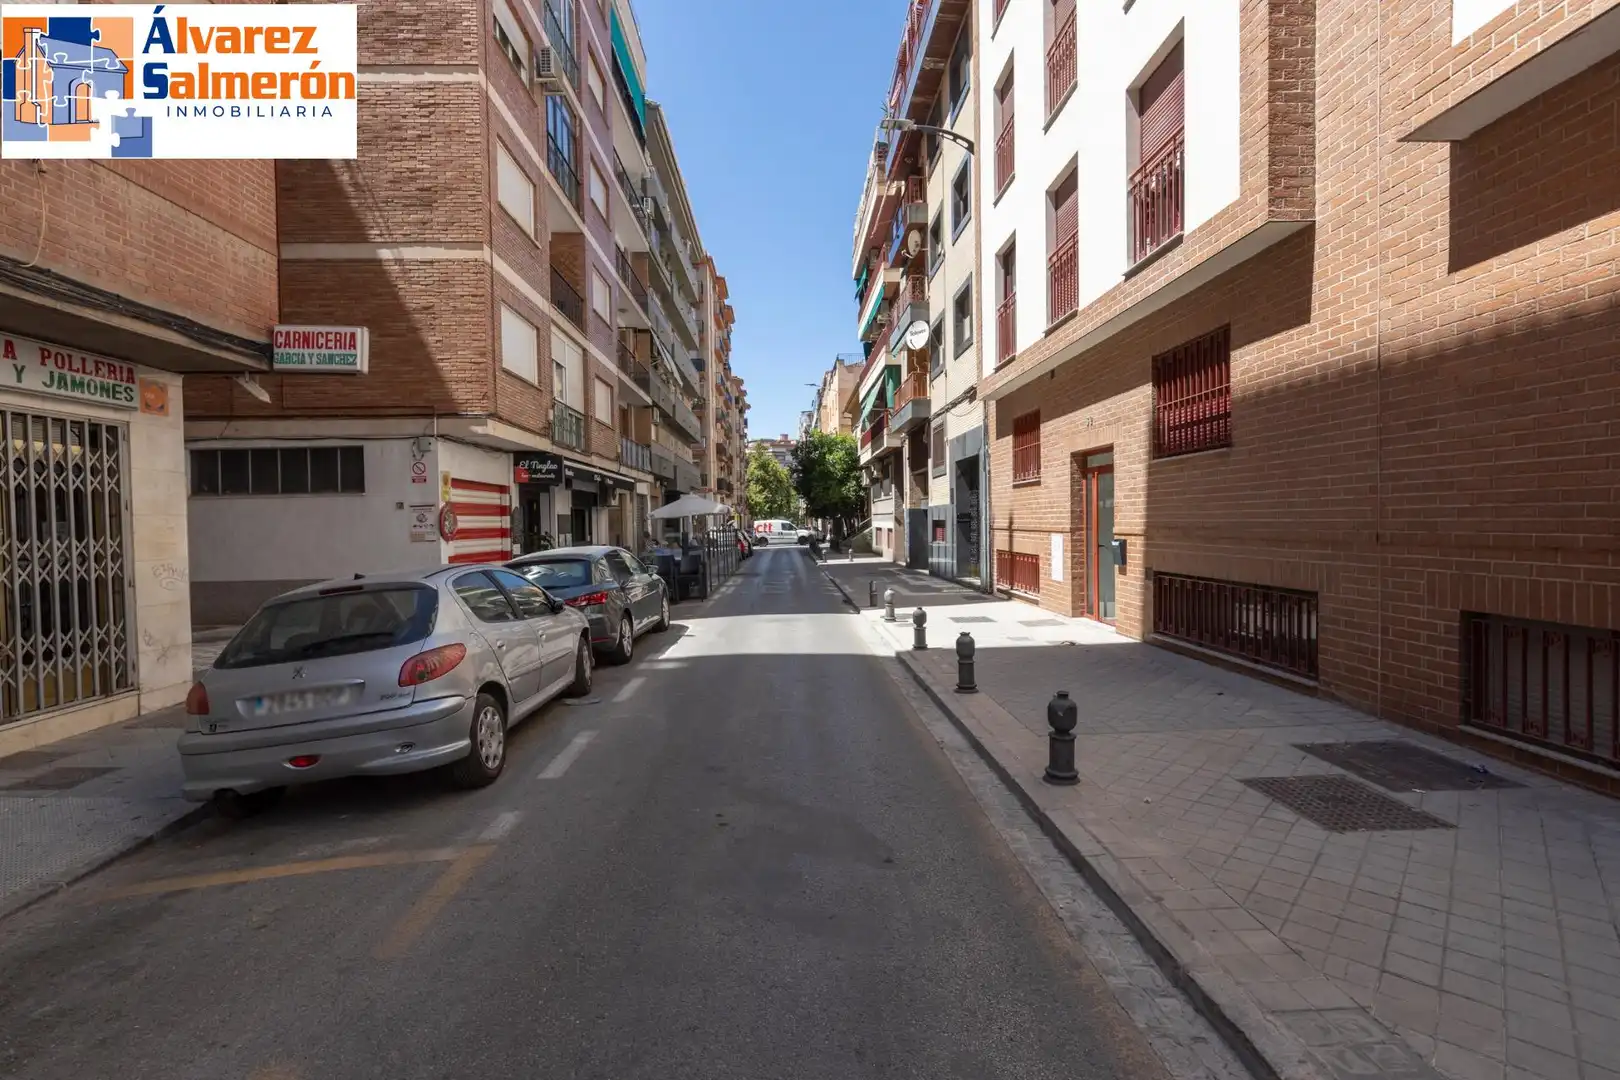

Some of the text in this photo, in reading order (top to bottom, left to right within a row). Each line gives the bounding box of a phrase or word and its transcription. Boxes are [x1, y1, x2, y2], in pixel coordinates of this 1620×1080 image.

[274, 330, 357, 350] CARNICERIA
[38, 346, 136, 385] POLLERIA
[273, 351, 357, 365] GARCIA Y SANCHEZ
[12, 363, 134, 403] Y JAMONES
[519, 460, 529, 469] El
